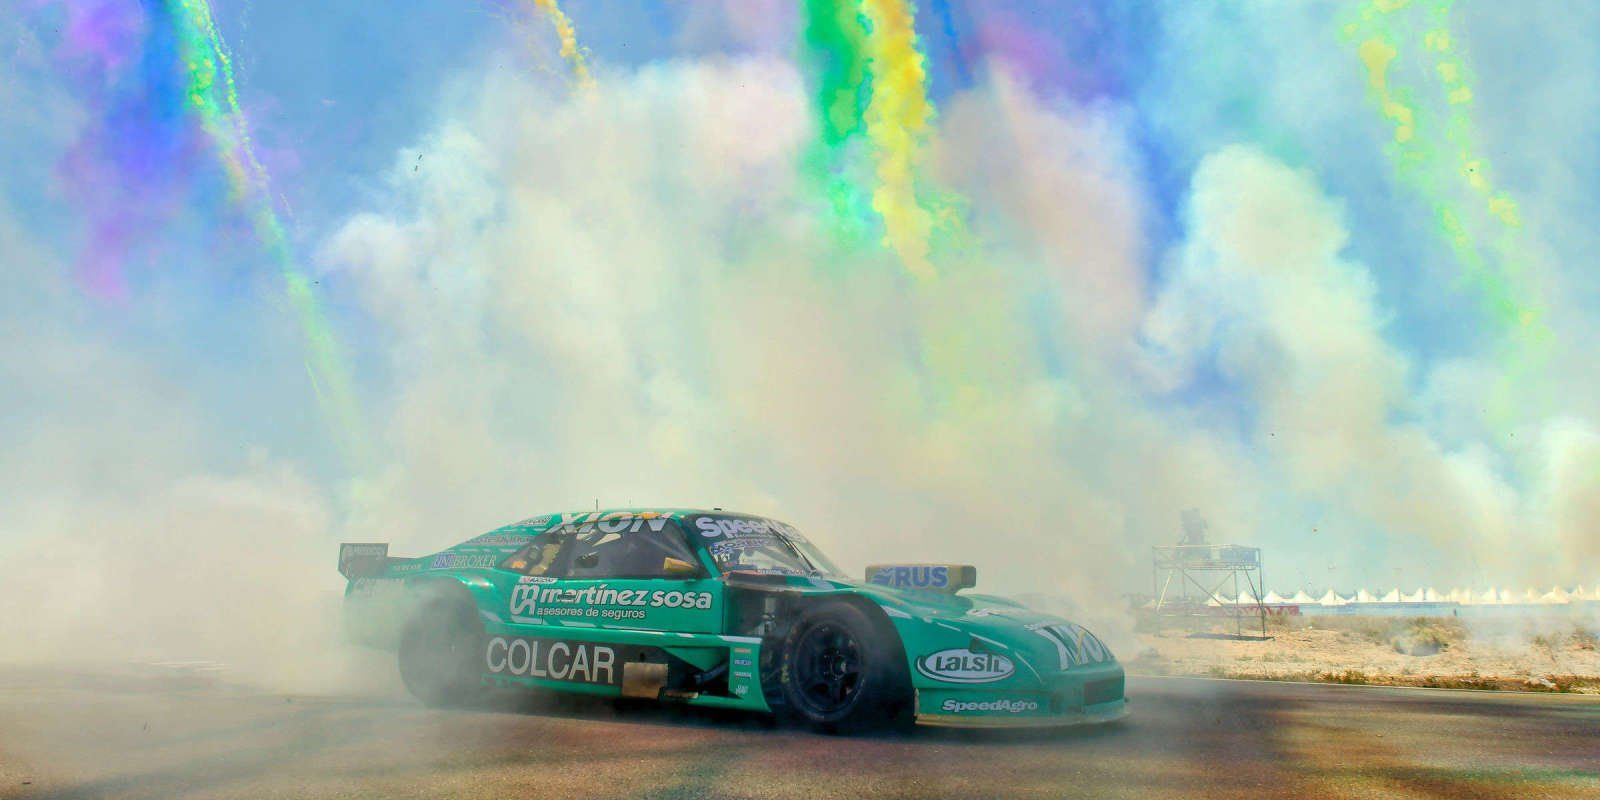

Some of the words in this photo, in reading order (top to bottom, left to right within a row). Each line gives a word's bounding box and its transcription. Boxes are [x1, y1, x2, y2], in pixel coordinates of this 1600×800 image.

[546, 512, 674, 534] XION
[895, 566, 949, 588] RUS
[541, 584, 648, 605] martínez
[651, 590, 712, 609] sosa
[537, 606, 583, 616] asesores
[585, 608, 599, 617] de
[601, 609, 645, 620] seguros
[486, 637, 615, 684] COLCAR
[942, 699, 1037, 713] SpeedAgro
